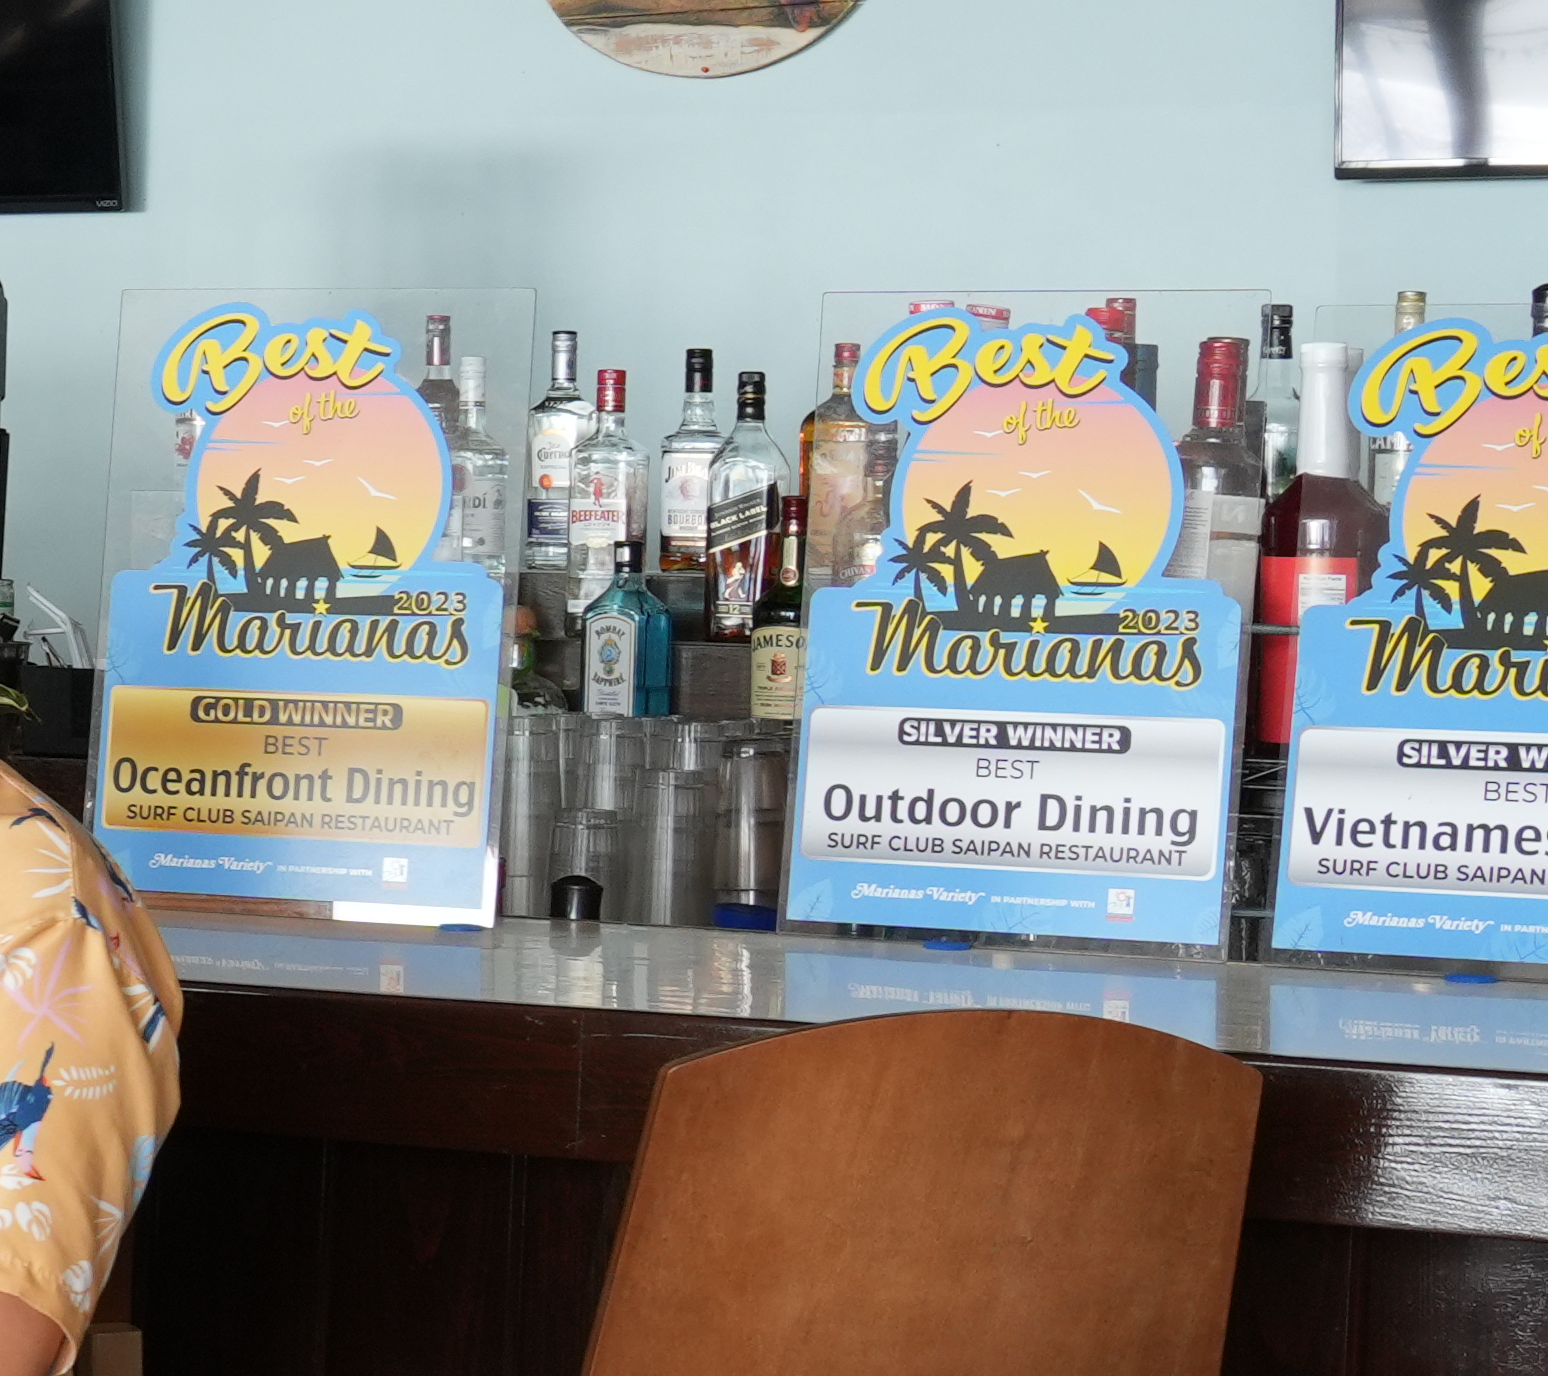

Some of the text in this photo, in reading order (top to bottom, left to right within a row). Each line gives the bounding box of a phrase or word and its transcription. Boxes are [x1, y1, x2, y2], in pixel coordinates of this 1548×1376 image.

[162, 312, 392, 413] Best
[864, 316, 1115, 423] Best
[288, 389, 360, 435] of the
[1002, 398, 1080, 445] of the
[665, 464, 687, 483] JIM
[571, 510, 626, 524] BEEFEATER
[739, 505, 767, 521] LABEL
[392, 590, 468, 615] 2023
[728, 603, 740, 615] 12
[150, 580, 471, 667] Marianas
[1117, 607, 1201, 636] 2023
[752, 633, 806, 653] JAMESO
[852, 599, 1203, 689] Marianas
[197, 698, 395, 729] GOLD WINNER
[263, 735, 329, 756] BEST
[902, 720, 1121, 750] SILVER WINNER
[975, 757, 1040, 780] BEST
[1402, 741, 1509, 768] SILVER
[113, 756, 476, 818] Oceanfront Dining
[126, 804, 454, 836] SURF CLUB SAIPAN RESTAURANT
[823, 783, 1198, 847] Outdoor Dining
[1303, 806, 1548, 857] Vietname
[149, 852, 273, 874] Marianas Variety
[827, 832, 1188, 867] SURF CLUB SAIPAN RESTAURANT
[1317, 858, 1546, 886] SURF CLUB SAIPAN
[850, 882, 986, 905] Marianas Variety
[1002, 896, 1067, 908] PARTNERSHIP
[1069, 899, 1095, 909] WITH
[1344, 910, 1494, 934] Marianas Variety
